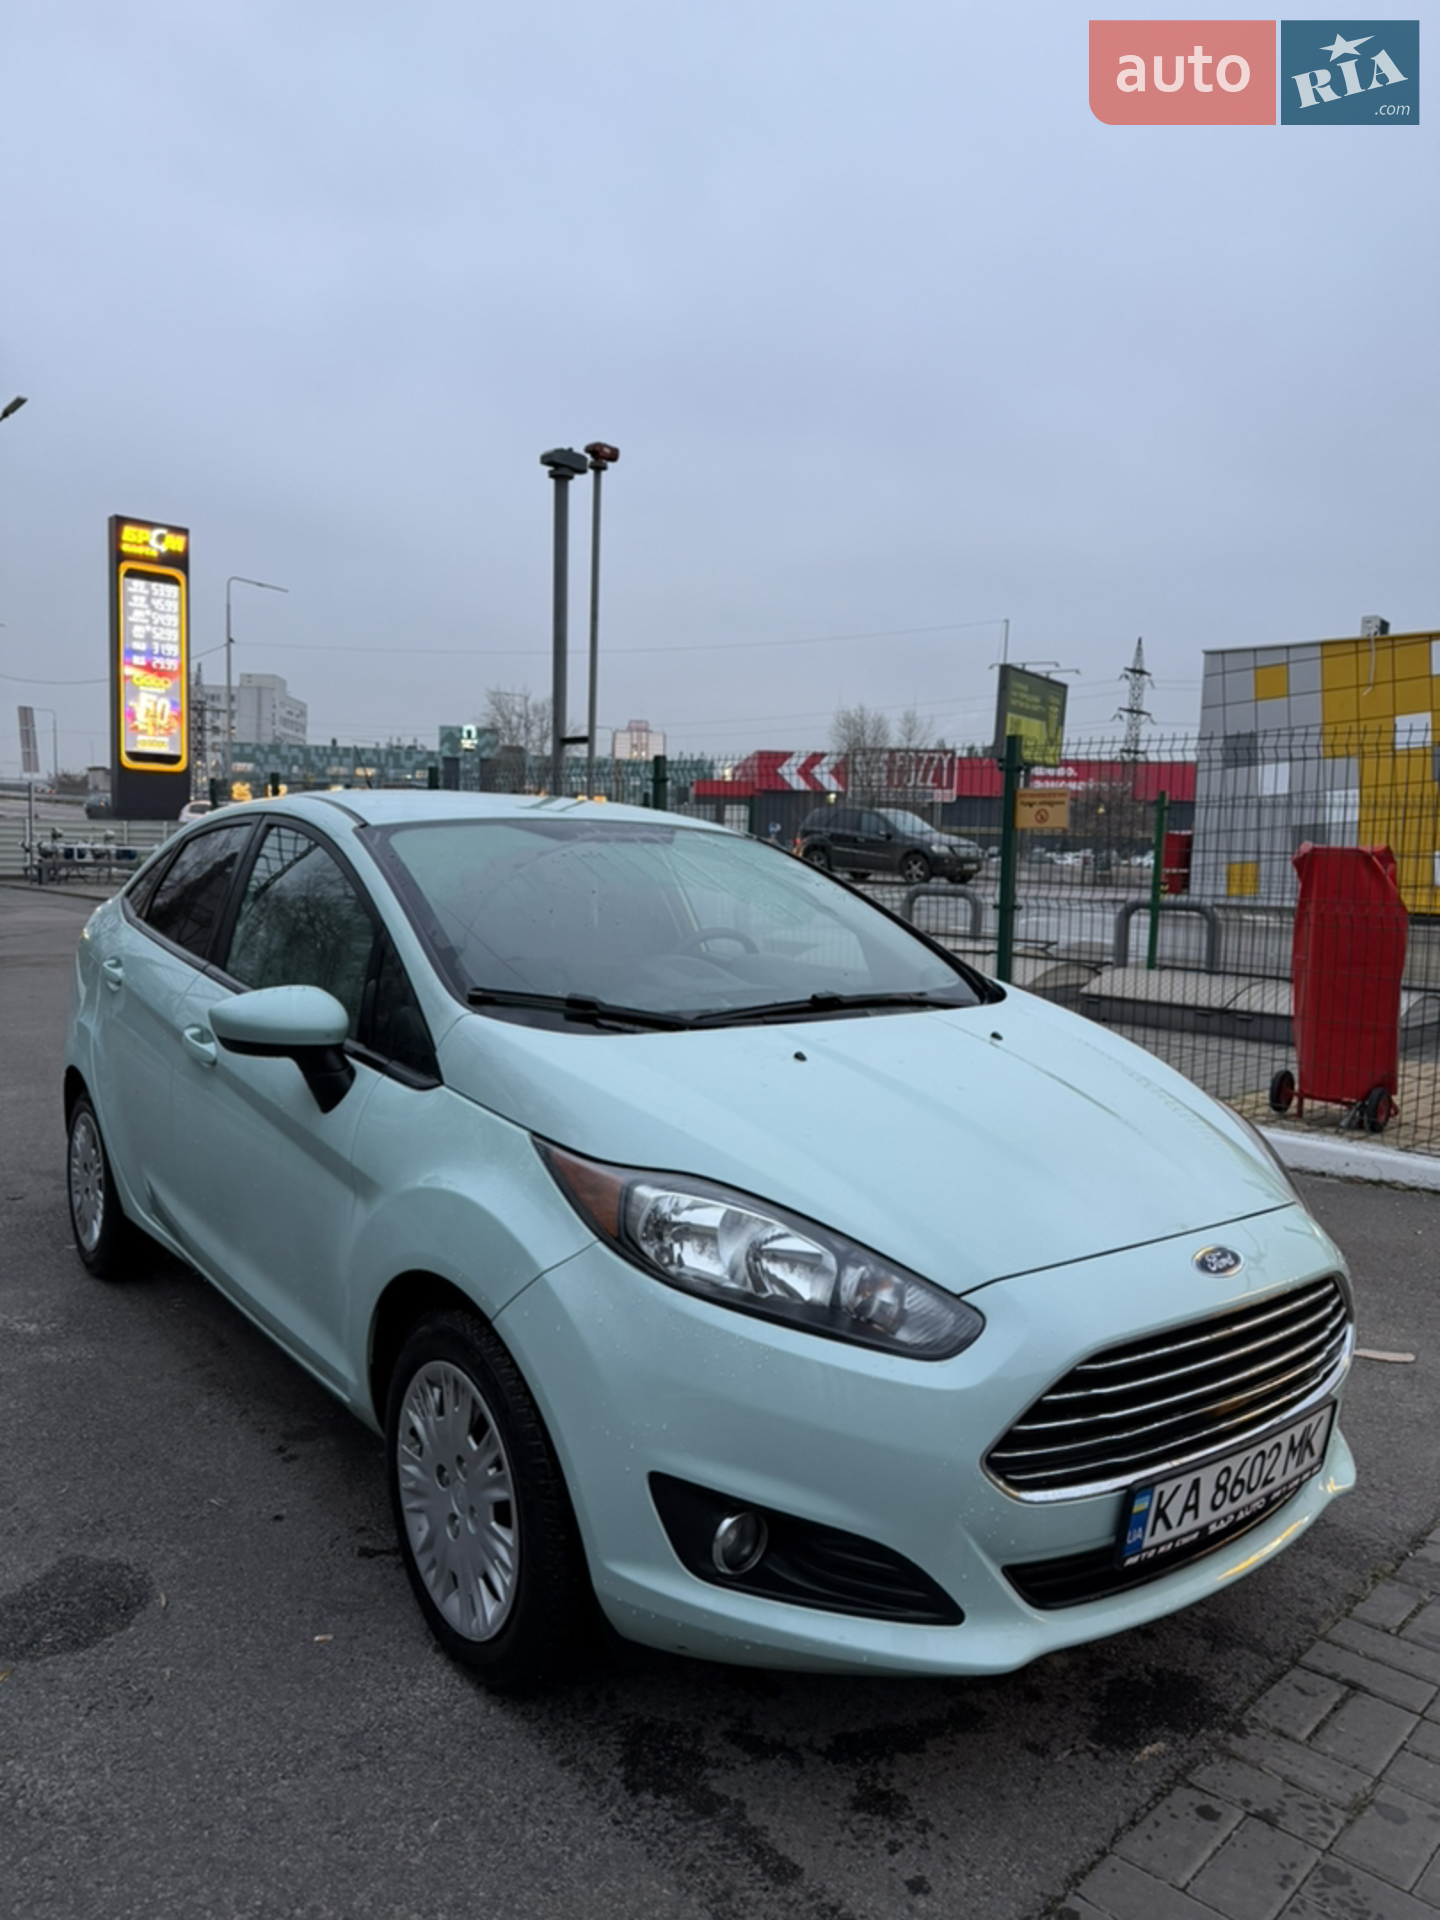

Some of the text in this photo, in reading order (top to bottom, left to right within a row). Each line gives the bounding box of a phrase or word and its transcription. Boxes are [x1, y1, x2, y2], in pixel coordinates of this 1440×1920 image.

[1149, 1477, 1201, 1538] KA
[1210, 1441, 1281, 1513] 8602
[1283, 1415, 1324, 1477] MK
[1126, 1527, 1144, 1544] UA
